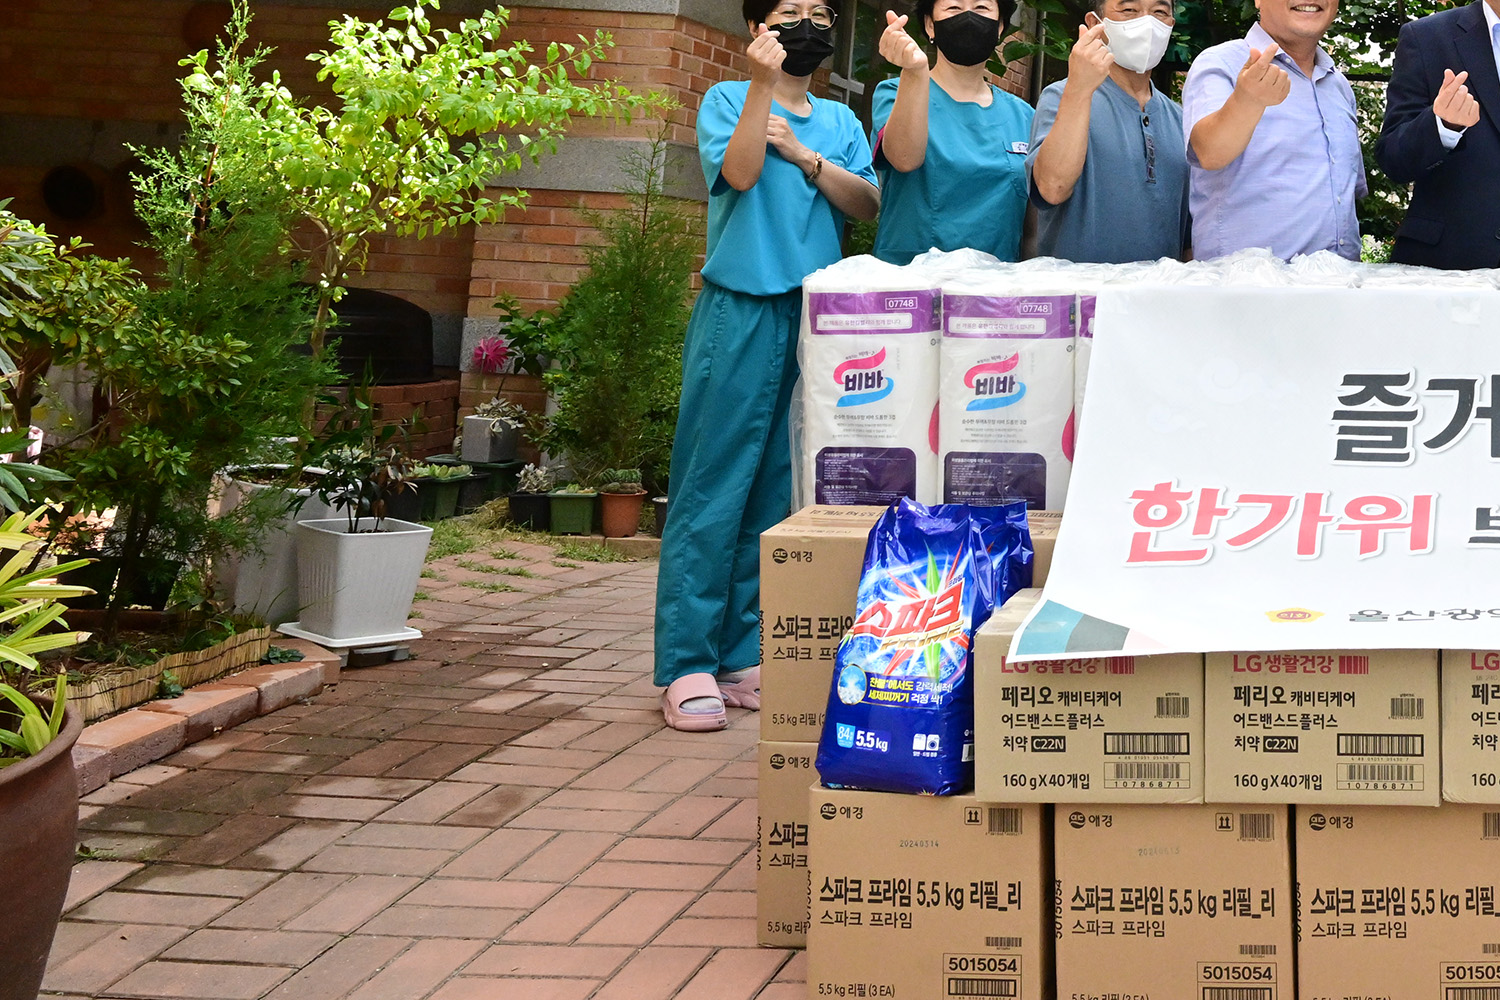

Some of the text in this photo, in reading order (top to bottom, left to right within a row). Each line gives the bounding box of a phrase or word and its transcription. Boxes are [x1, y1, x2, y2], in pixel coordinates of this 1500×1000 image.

[888, 299, 914, 308] 07748
[1022, 304, 1048, 313] 07748
[845, 370, 883, 392] 비바
[975, 375, 1015, 396] 비바
[1126, 481, 1431, 564] 한가위
[791, 551, 813, 563] 애경
[853, 580, 963, 637] 스파크
[772, 615, 813, 641] 스파크
[880, 620, 965, 651] PRIME
[773, 646, 813, 661] 스파크
[1471, 652, 1500, 671] LG
[1233, 654, 1335, 674] LG 생활건강
[915, 681, 953, 693] 강력세척!
[868, 690, 909, 703] 세제찌꺼기
[910, 693, 928, 704] 걱정
[1001, 686, 1122, 707] 페리오 캐비티케어
[1233, 685, 1356, 708] 페리오 캐비티케어
[772, 713, 818, 726] 5.5 kg 리필
[1001, 713, 1105, 730] 어드밴스드플러스
[1233, 712, 1338, 730] 어드밴스드플러스
[1003, 736, 1064, 752] 치약 C22N
[1234, 735, 1297, 752] 치약 C22N
[1472, 734, 1498, 751] 치약
[788, 756, 810, 769] 애경
[840, 806, 864, 819] 애경
[1088, 814, 1113, 828] 애경
[1329, 816, 1354, 829] 애경
[769, 822, 809, 848] 스파크
[769, 853, 808, 869] 스파크
[819, 876, 864, 905] 스파크
[868, 878, 912, 907] 프라임
[916, 881, 941, 908] 5.5
[945, 882, 964, 911] kg
[969, 880, 1022, 911] 리필_리
[1070, 885, 1115, 914] 스파크
[1119, 886, 1164, 915] 프라임
[1169, 889, 1193, 916] 5.5
[1198, 889, 1217, 918] kg
[1222, 887, 1275, 919] 리필_리
[1310, 887, 1356, 916] 스파크
[1360, 887, 1406, 916] 프라임
[1411, 888, 1435, 916] 5.5
[1440, 888, 1460, 917] kg
[767, 920, 793, 934] 5.5 kg
[820, 910, 912, 929] 스파크 프라임
[1071, 919, 1165, 938] 스파크 프라임
[1311, 922, 1407, 939] 스파크 프라임
[948, 957, 1018, 973] 5015054
[1202, 966, 1273, 981] 5015054
[818, 983, 896, 998] 5.5 kg 리필 (3 EA)
